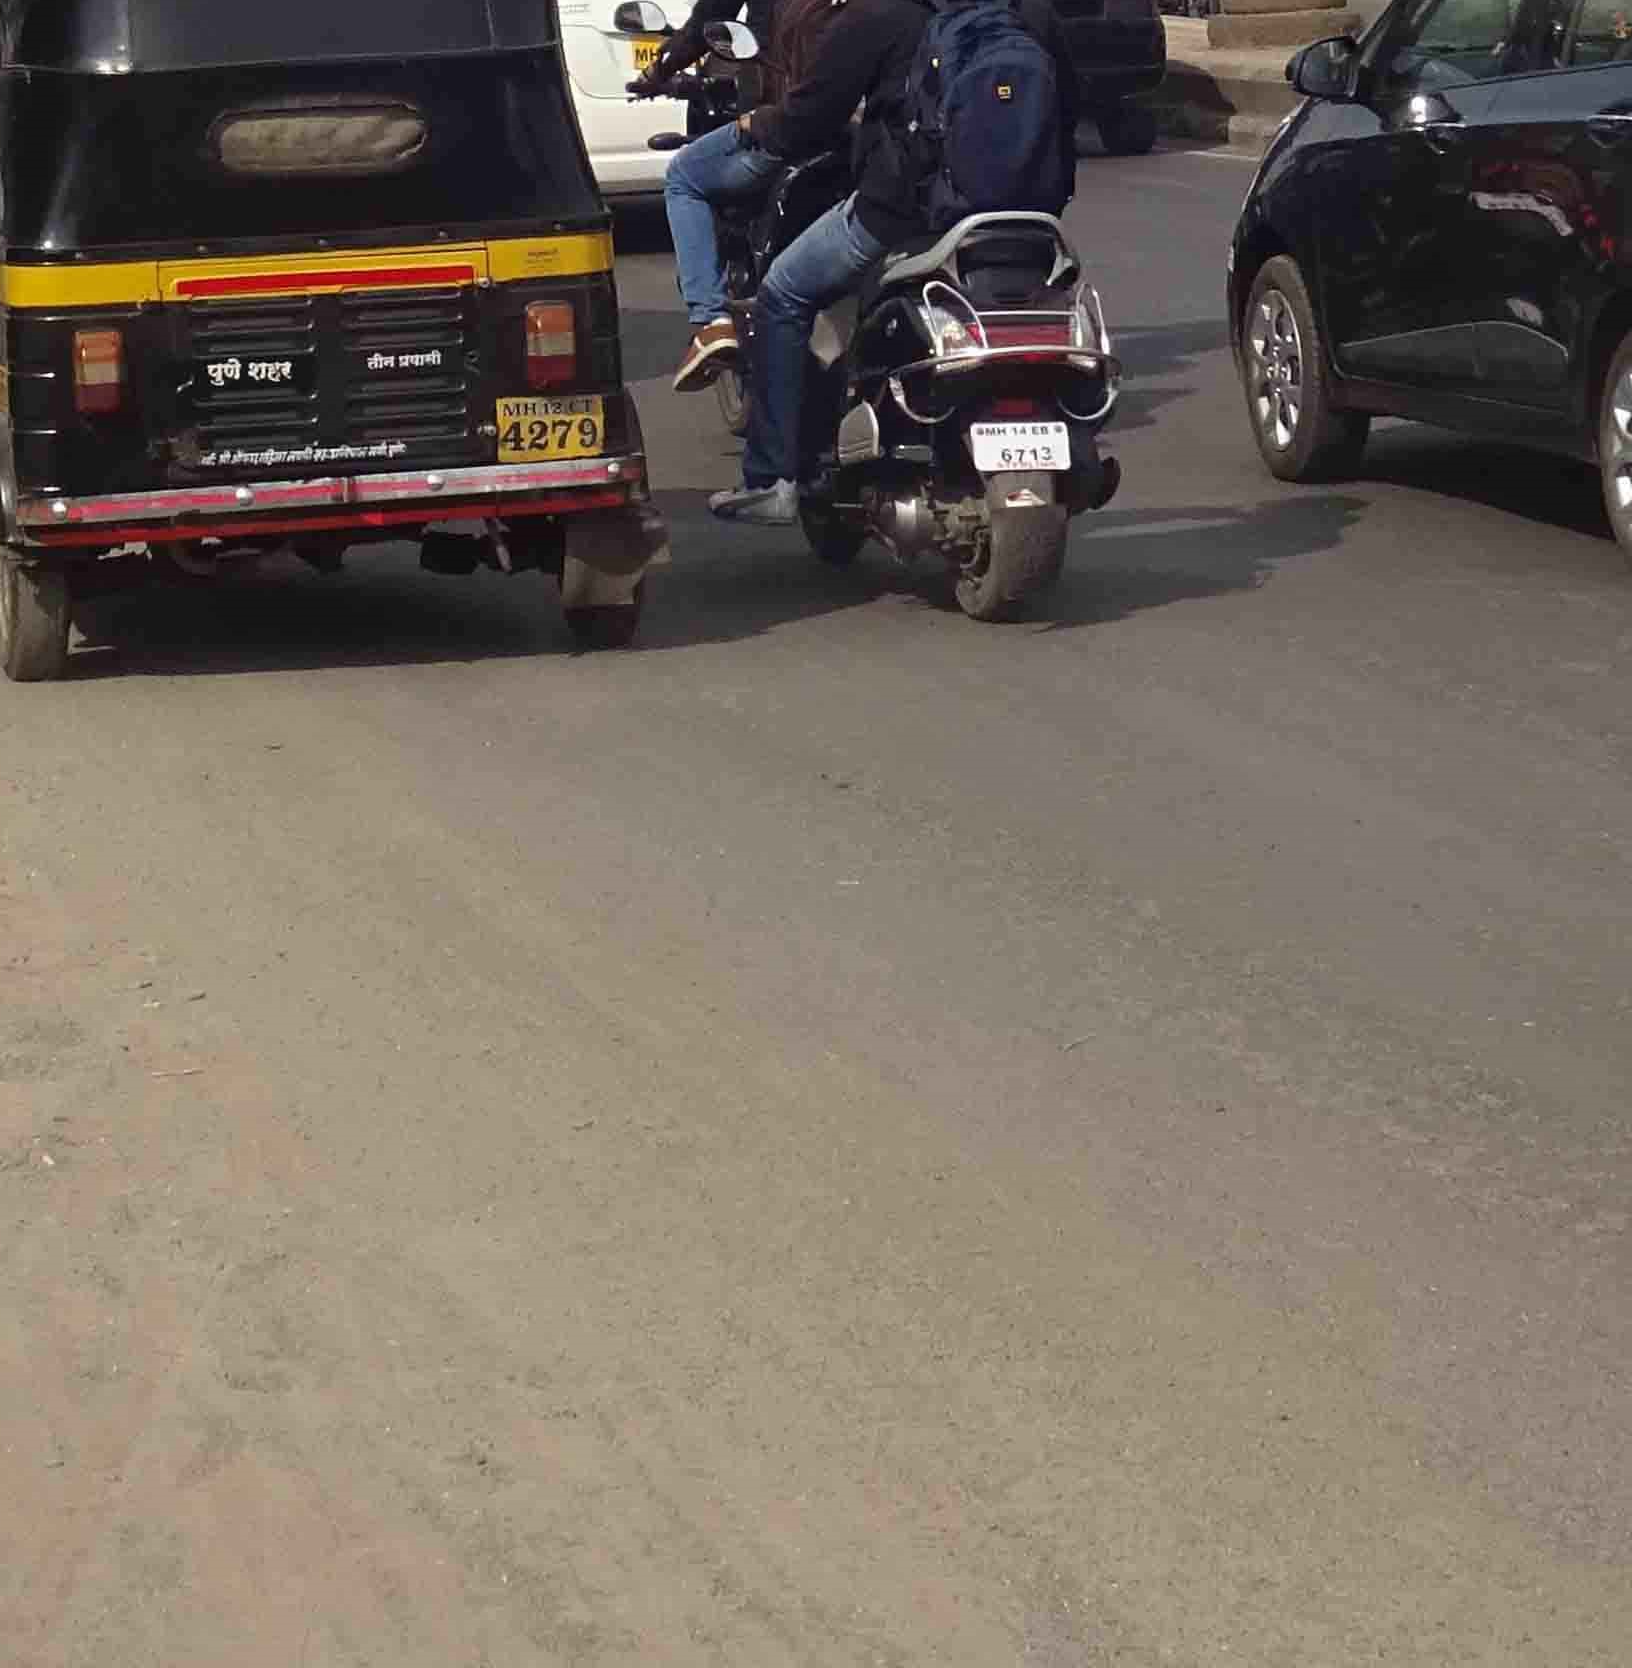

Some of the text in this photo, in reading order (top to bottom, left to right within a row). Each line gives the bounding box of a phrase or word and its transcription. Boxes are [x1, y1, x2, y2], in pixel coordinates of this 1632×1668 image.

[499, 418, 598, 452] 4279
[985, 426, 1007, 437] MH
[1001, 445, 1053, 462] 6713
